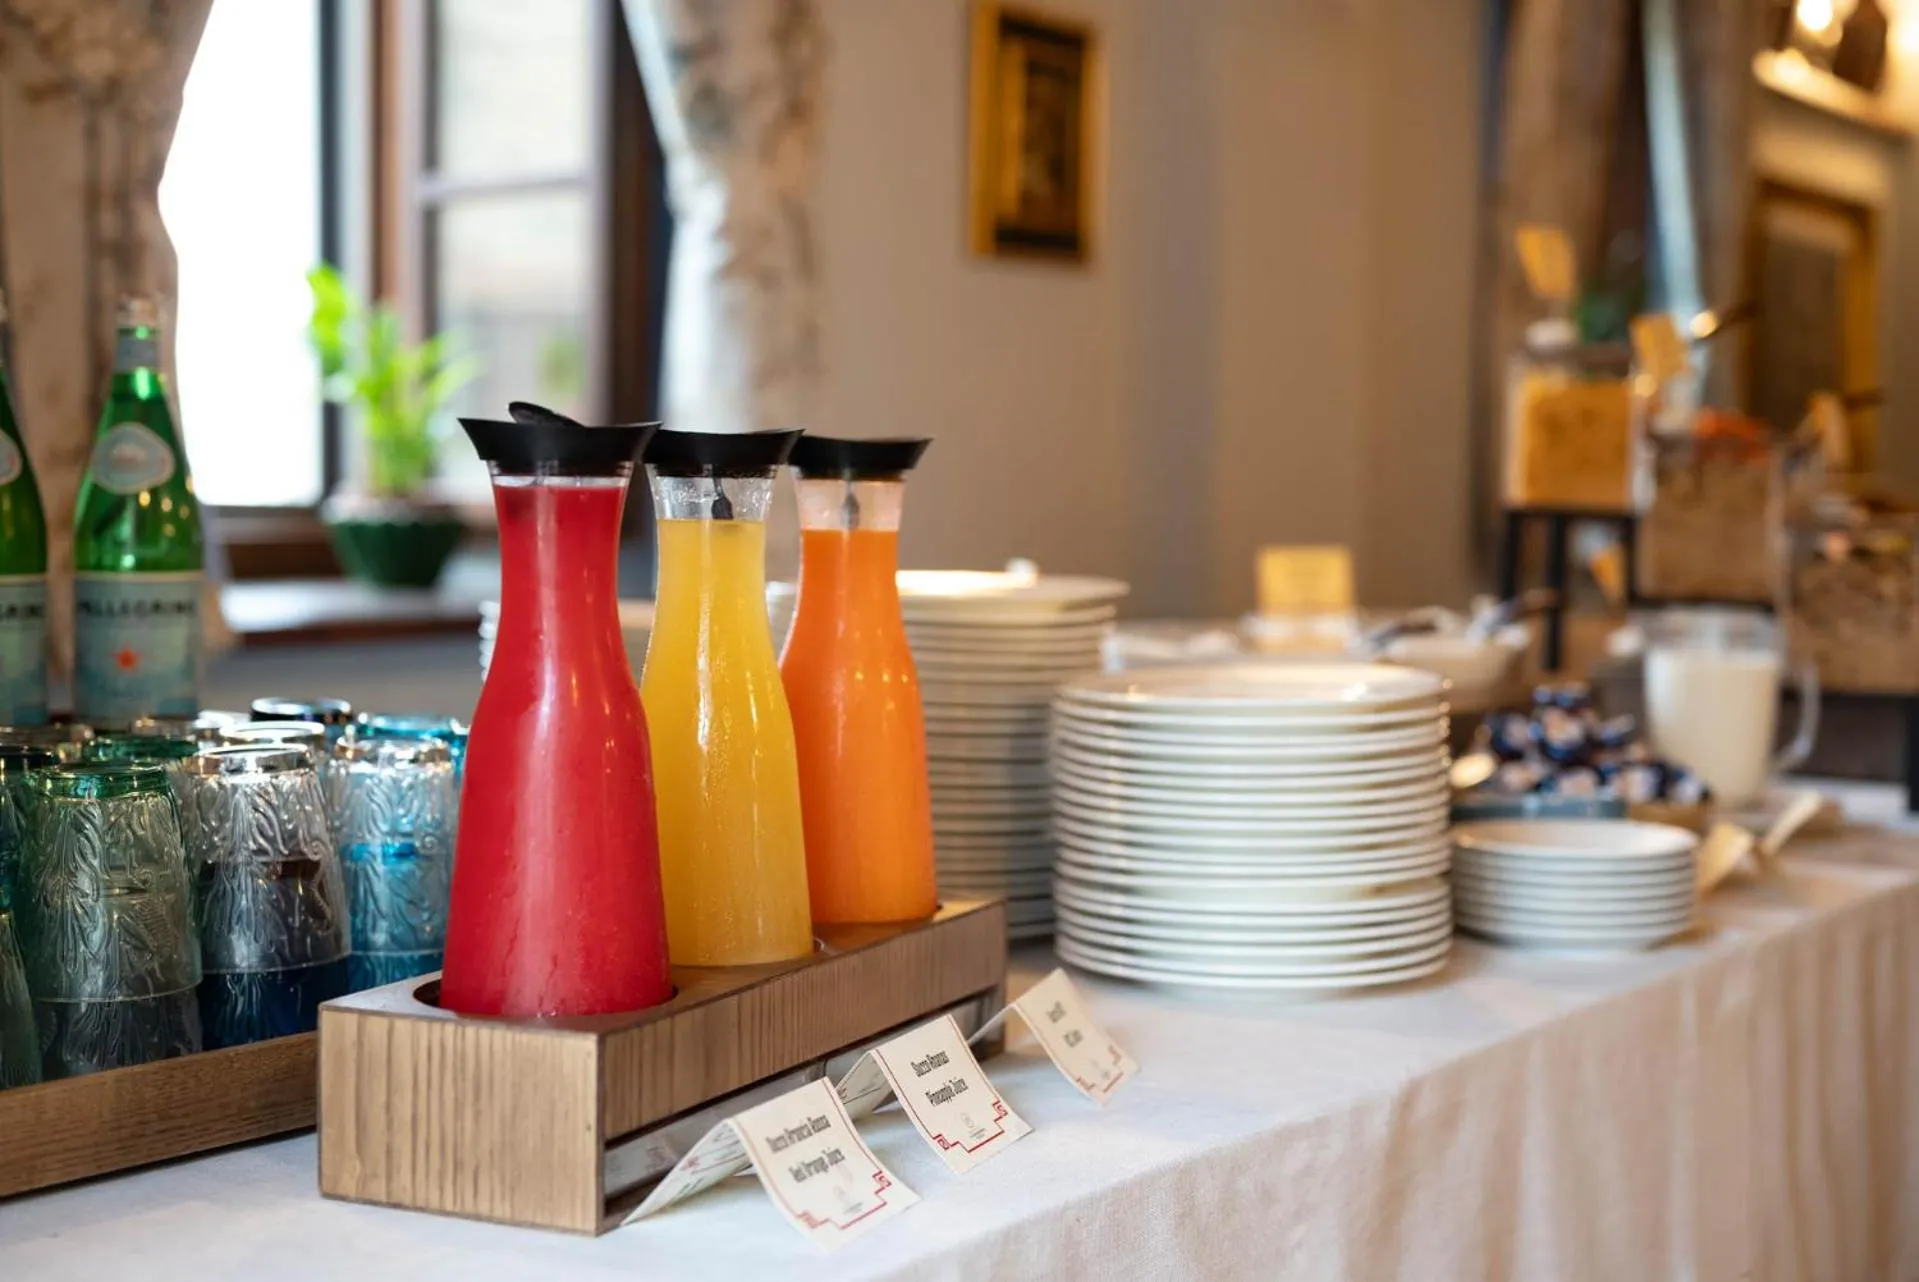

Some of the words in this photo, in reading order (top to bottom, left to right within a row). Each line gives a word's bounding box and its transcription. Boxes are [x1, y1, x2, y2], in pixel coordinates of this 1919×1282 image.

[925, 1083, 955, 1106] Pineapple
[948, 1077, 968, 1094] Juice
[801, 1156, 829, 1176] Orange
[821, 1147, 845, 1166] Juice
